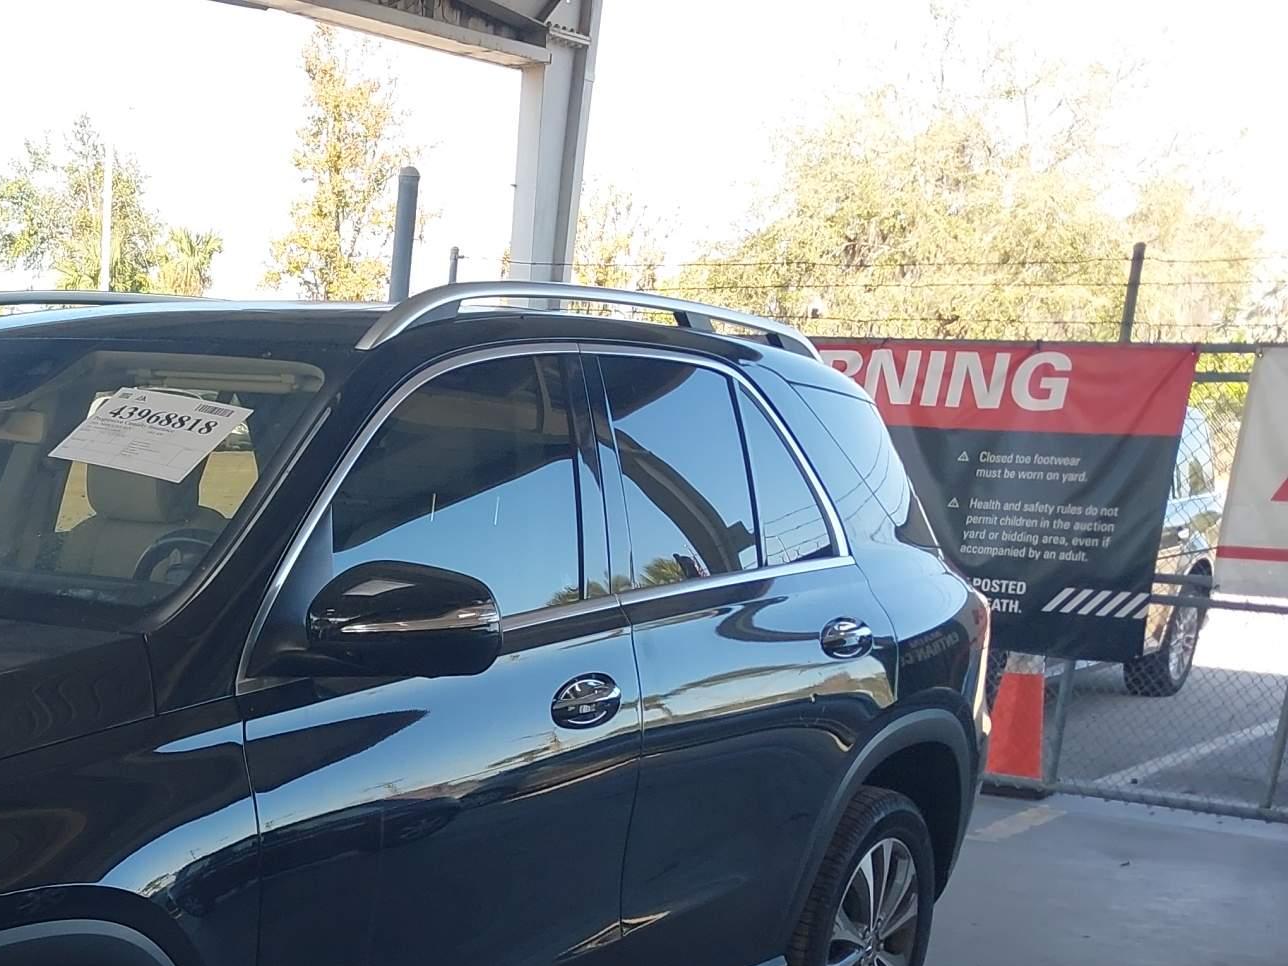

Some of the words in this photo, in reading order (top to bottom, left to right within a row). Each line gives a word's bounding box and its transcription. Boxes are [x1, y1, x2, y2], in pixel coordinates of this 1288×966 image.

[109, 405, 218, 435] 43968818
[979, 451, 1013, 464] Closed
[1015, 454, 1032, 464] toe
[1033, 454, 1081, 467] footwear
[975, 468, 1001, 479] must
[1003, 468, 1016, 479] be
[1017, 470, 1044, 480] worn
[1046, 472, 1060, 481] on
[1061, 472, 1088, 484] yard.
[969, 498, 1001, 511] Health
[1003, 500, 1022, 512] and
[1023, 501, 1055, 515] safety
[1056, 504, 1083, 515] rules
[1085, 505, 1098, 517] do
[1099, 506, 1120, 518] not
[966, 514, 998, 526] permit
[999, 515, 1038, 528] children
[1039, 517, 1050, 529] in
[1052, 518, 1071, 531] the
[1073, 521, 1115, 534] auction
[962, 529, 986, 541] yard
[988, 532, 1000, 541] or
[1001, 531, 1039, 546] bidding
[1041, 534, 1069, 547] area,
[1071, 537, 1099, 548] even
[1101, 535, 1113, 549] if
[960, 543, 1026, 559] accompanied
[1028, 547, 1041, 561] by
[1043, 550, 1057, 561] an
[1058, 550, 1089, 563] adult.
[973, 578, 1027, 595] POSTED
